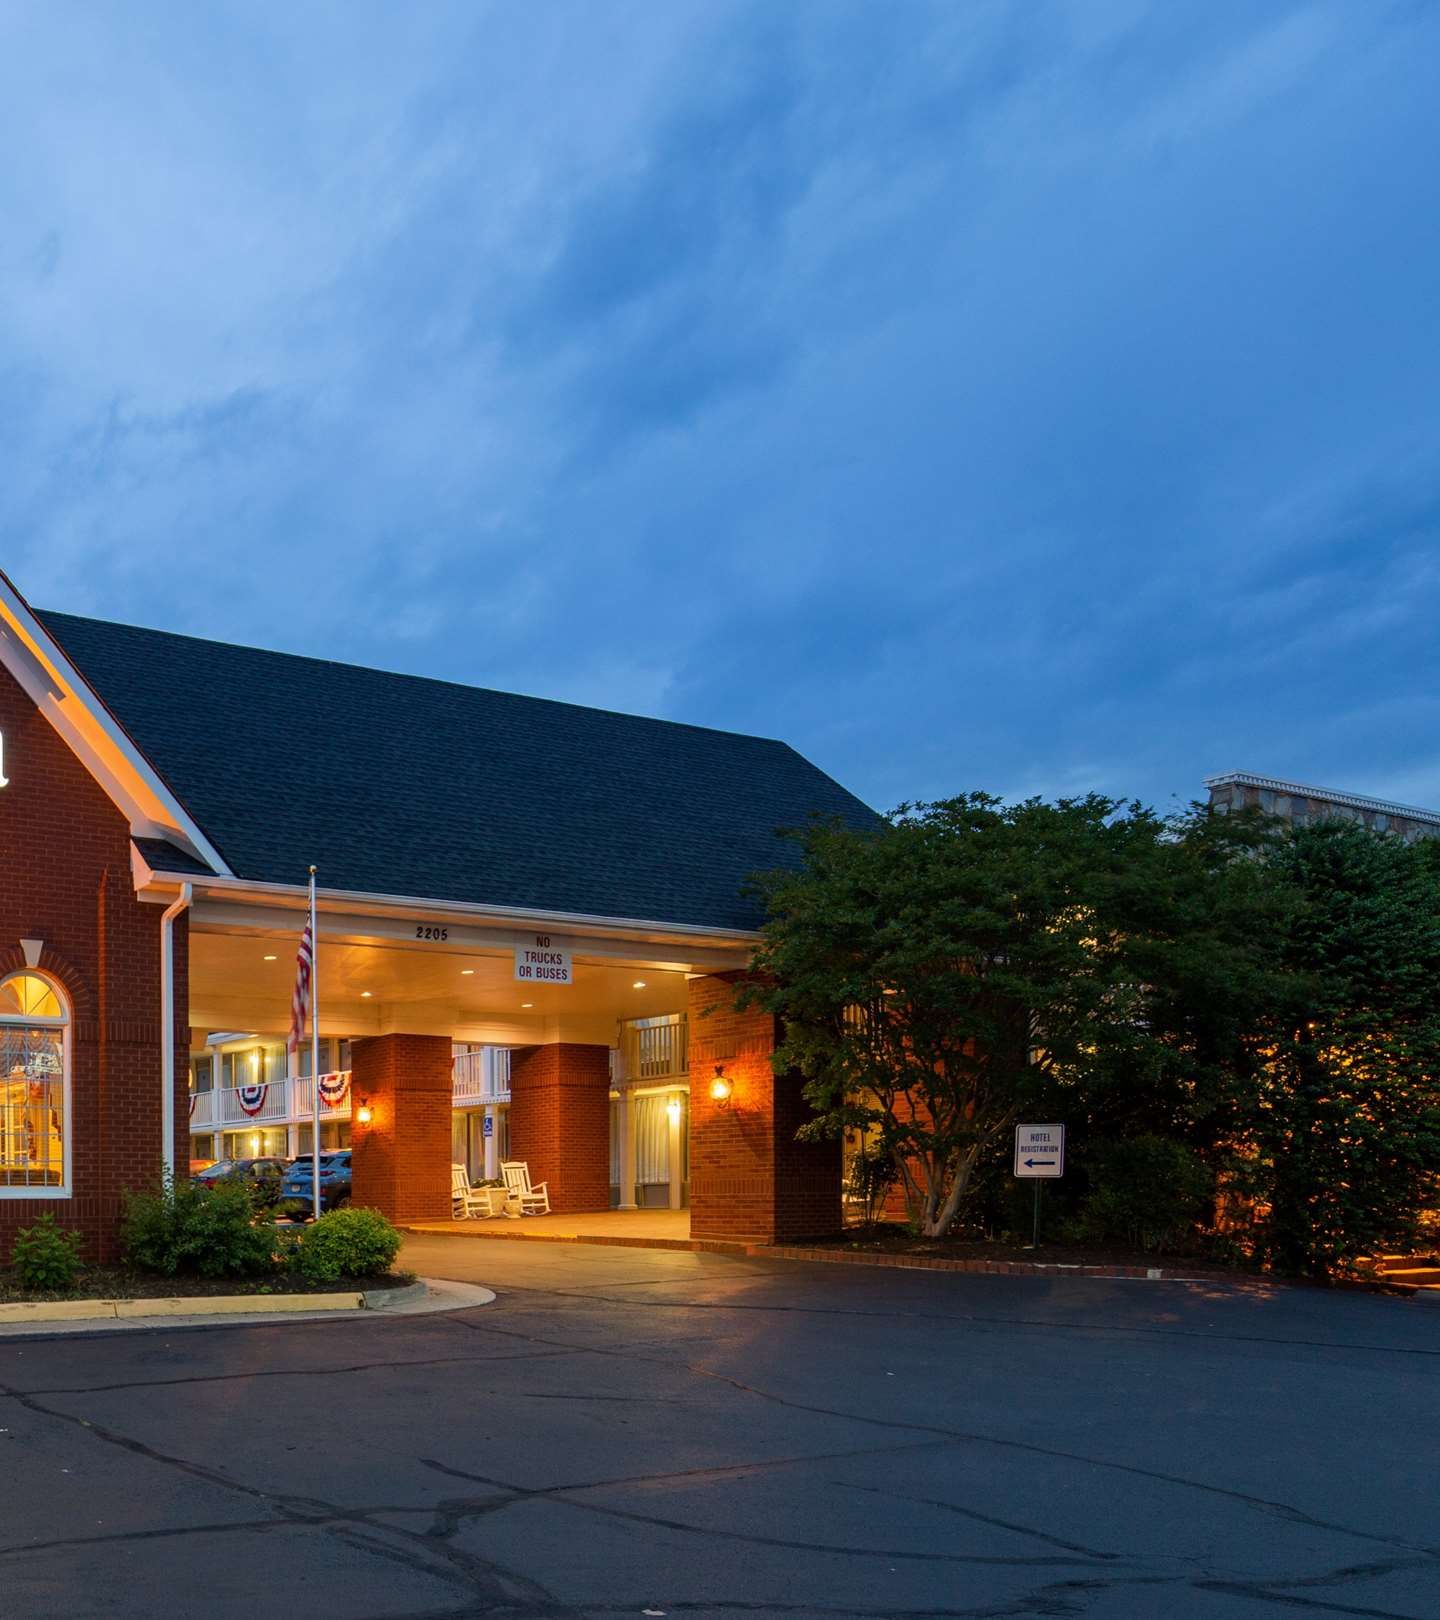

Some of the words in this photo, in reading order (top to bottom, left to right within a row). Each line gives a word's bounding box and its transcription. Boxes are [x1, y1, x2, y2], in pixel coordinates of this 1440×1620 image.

[416, 926, 448, 941] 2205
[536, 935, 550, 948] NO
[525, 951, 562, 965] TRUCKS
[519, 965, 532, 979] OR
[536, 966, 568, 981] BUSES
